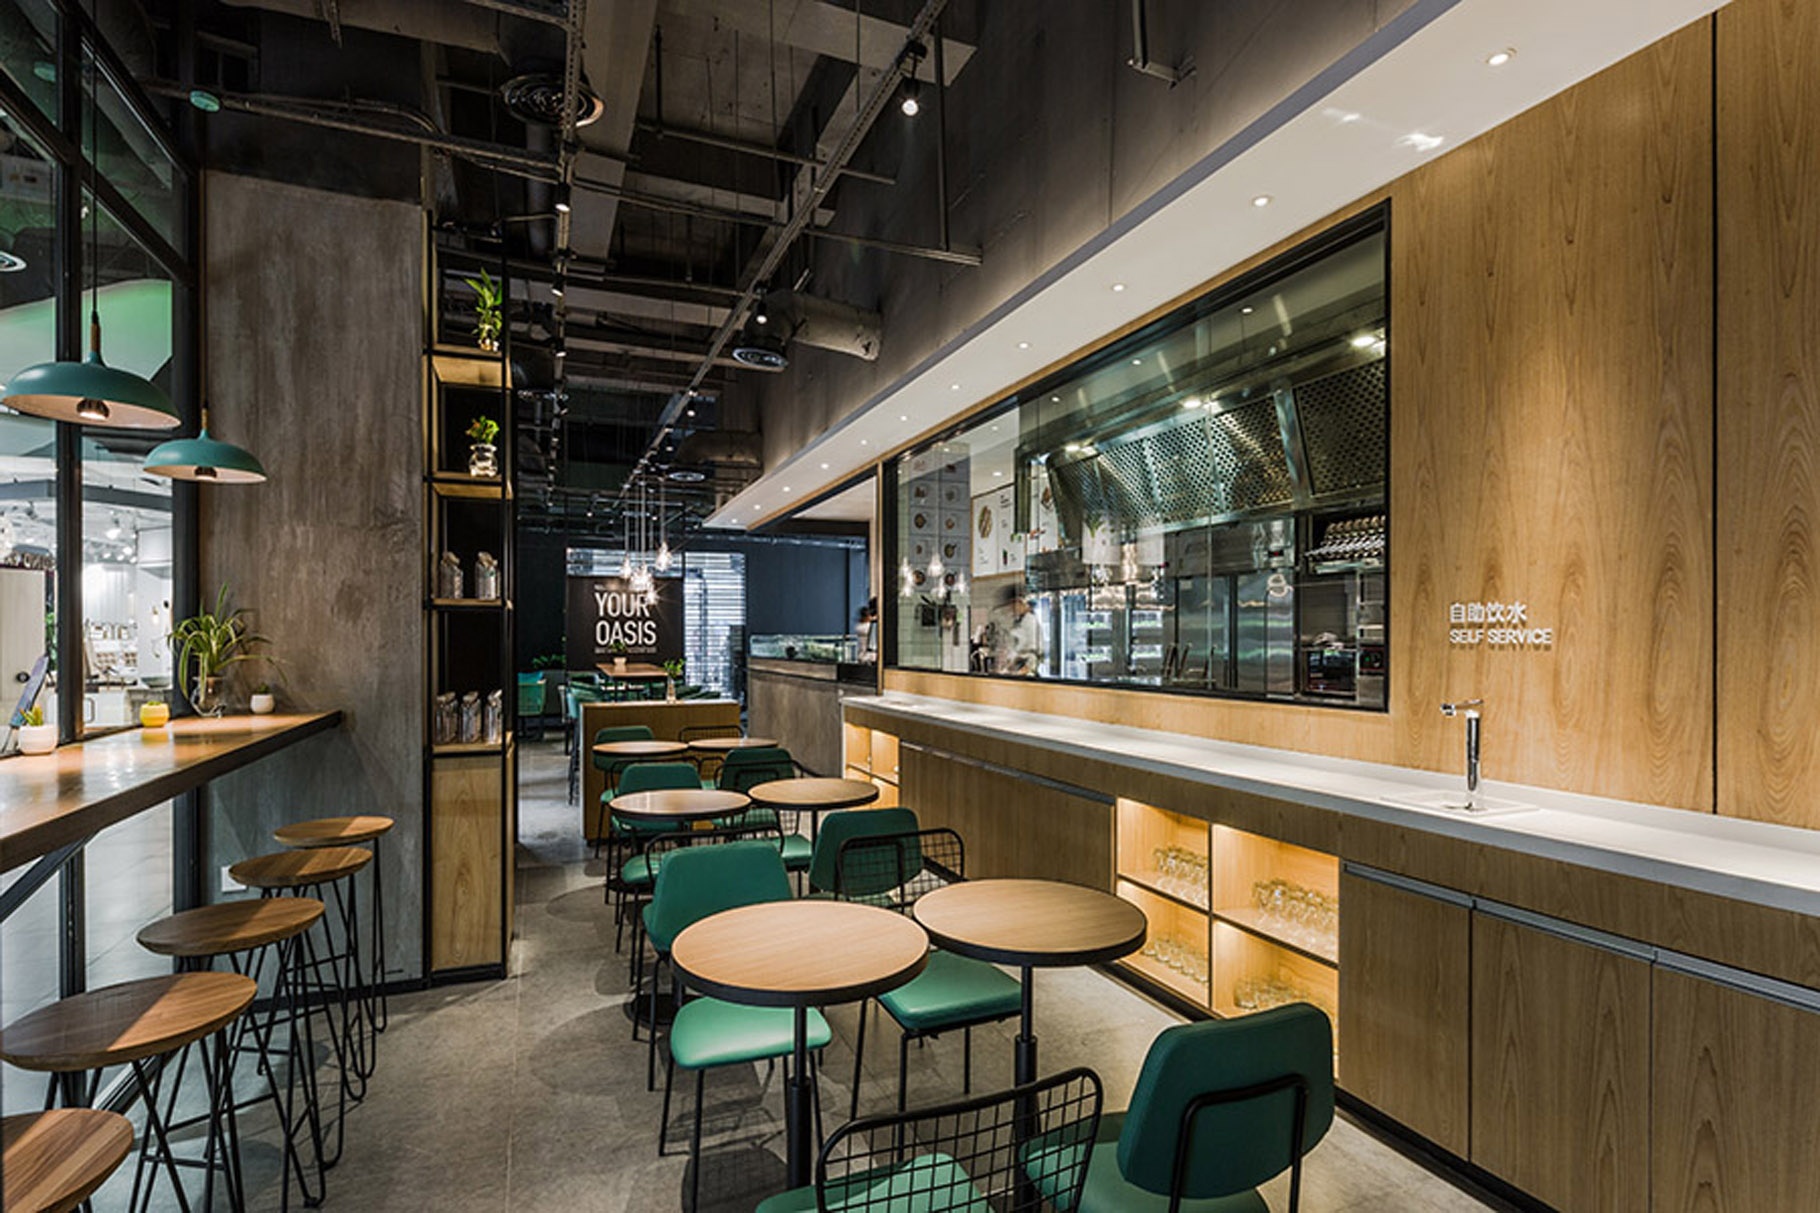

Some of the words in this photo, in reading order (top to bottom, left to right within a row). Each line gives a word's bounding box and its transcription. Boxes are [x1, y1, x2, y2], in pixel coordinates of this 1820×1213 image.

[594, 592, 650, 617] YOUR
[1450, 601, 1527, 623] 自助饮水
[595, 620, 657, 645] OASIS
[1449, 628, 1484, 644] SELF
[1487, 628, 1552, 644] SERVICE
